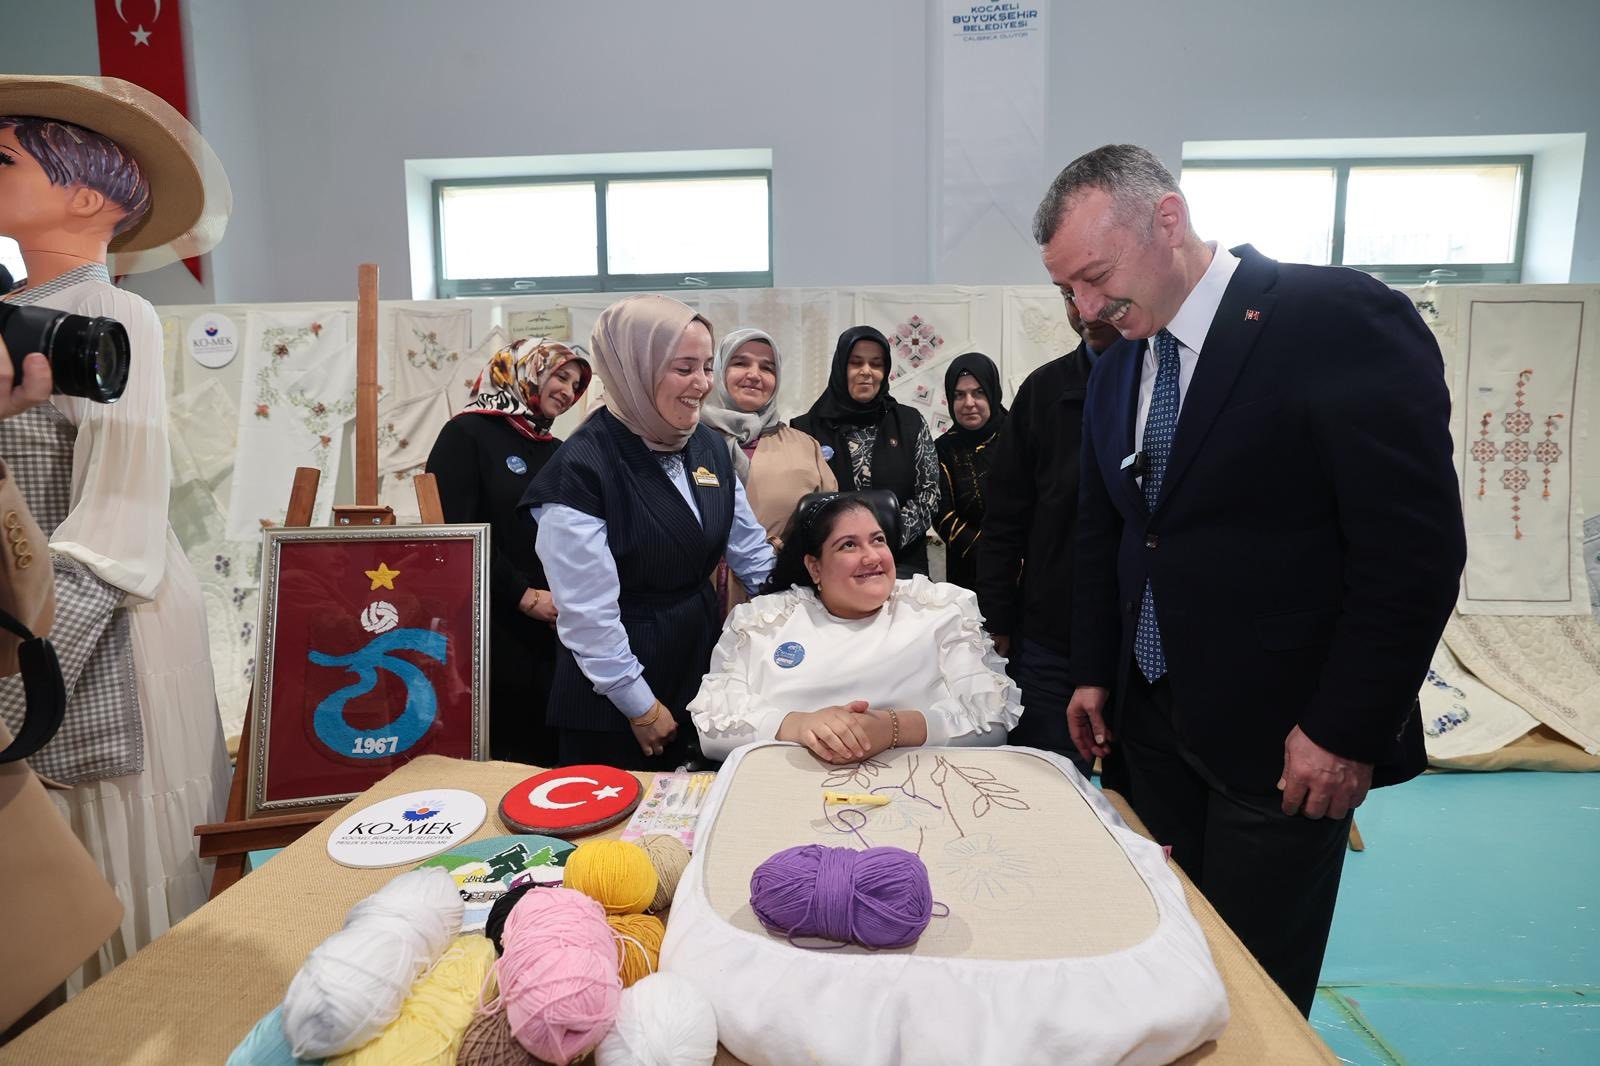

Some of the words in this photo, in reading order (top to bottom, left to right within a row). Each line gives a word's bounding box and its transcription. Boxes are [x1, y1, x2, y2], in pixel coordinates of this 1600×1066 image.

[971, 3, 1019, 13] KOCAELİ
[952, 10, 1038, 24] BÜYÜKŞEHİR
[963, 20, 1028, 32] BELEDİYESİ
[193, 336, 232, 348] KO-MEK
[352, 736, 399, 754] 1967
[348, 822, 462, 835] KO-MEK
